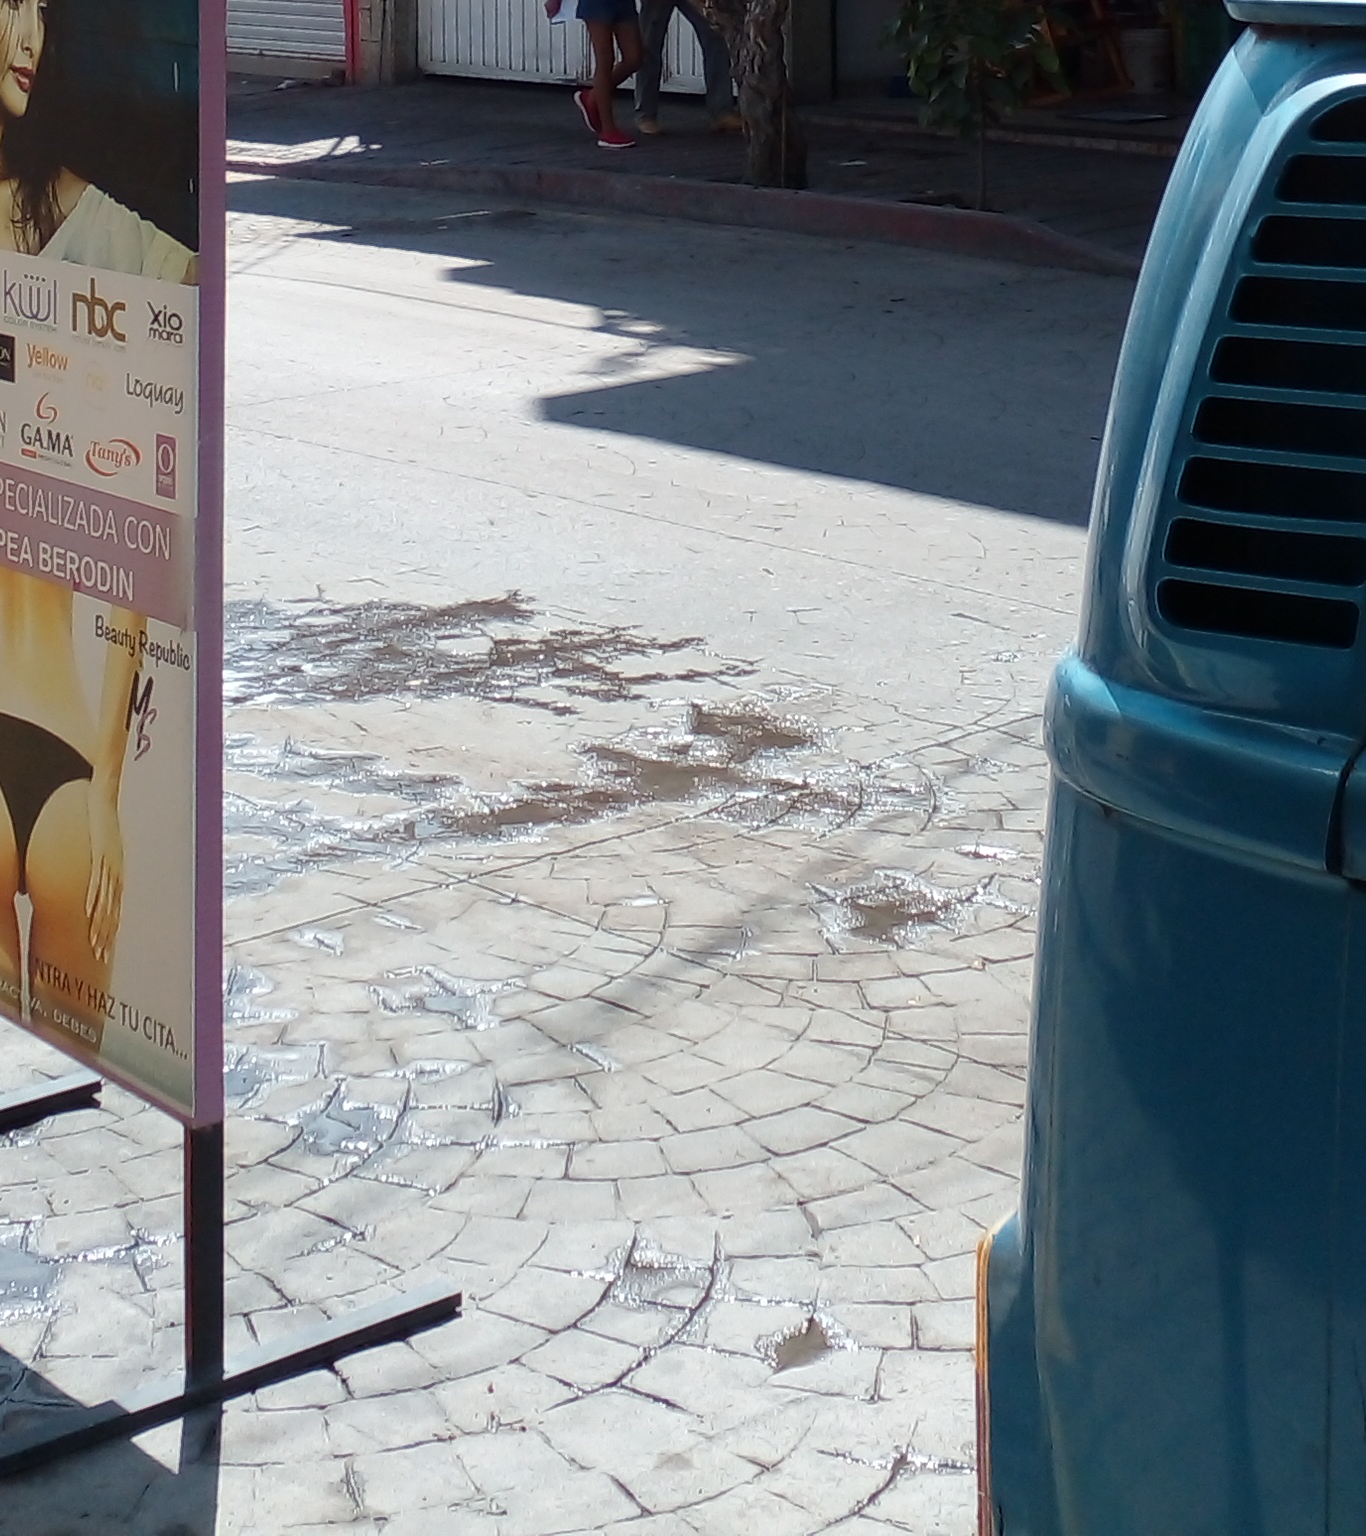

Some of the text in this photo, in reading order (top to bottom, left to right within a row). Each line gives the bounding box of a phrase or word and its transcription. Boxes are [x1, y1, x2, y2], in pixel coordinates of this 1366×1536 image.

[89, 440, 133, 469] Tany's
[124, 516, 172, 561] CON
[39, 541, 134, 602] BERODIN
[95, 614, 191, 671] Beauty Republic
[33, 958, 71, 996] NTRA
[74, 977, 85, 1002] Y
[87, 984, 116, 1020] HAZ
[119, 1001, 139, 1032] TU
[52, 1009, 97, 1043] DEBES
